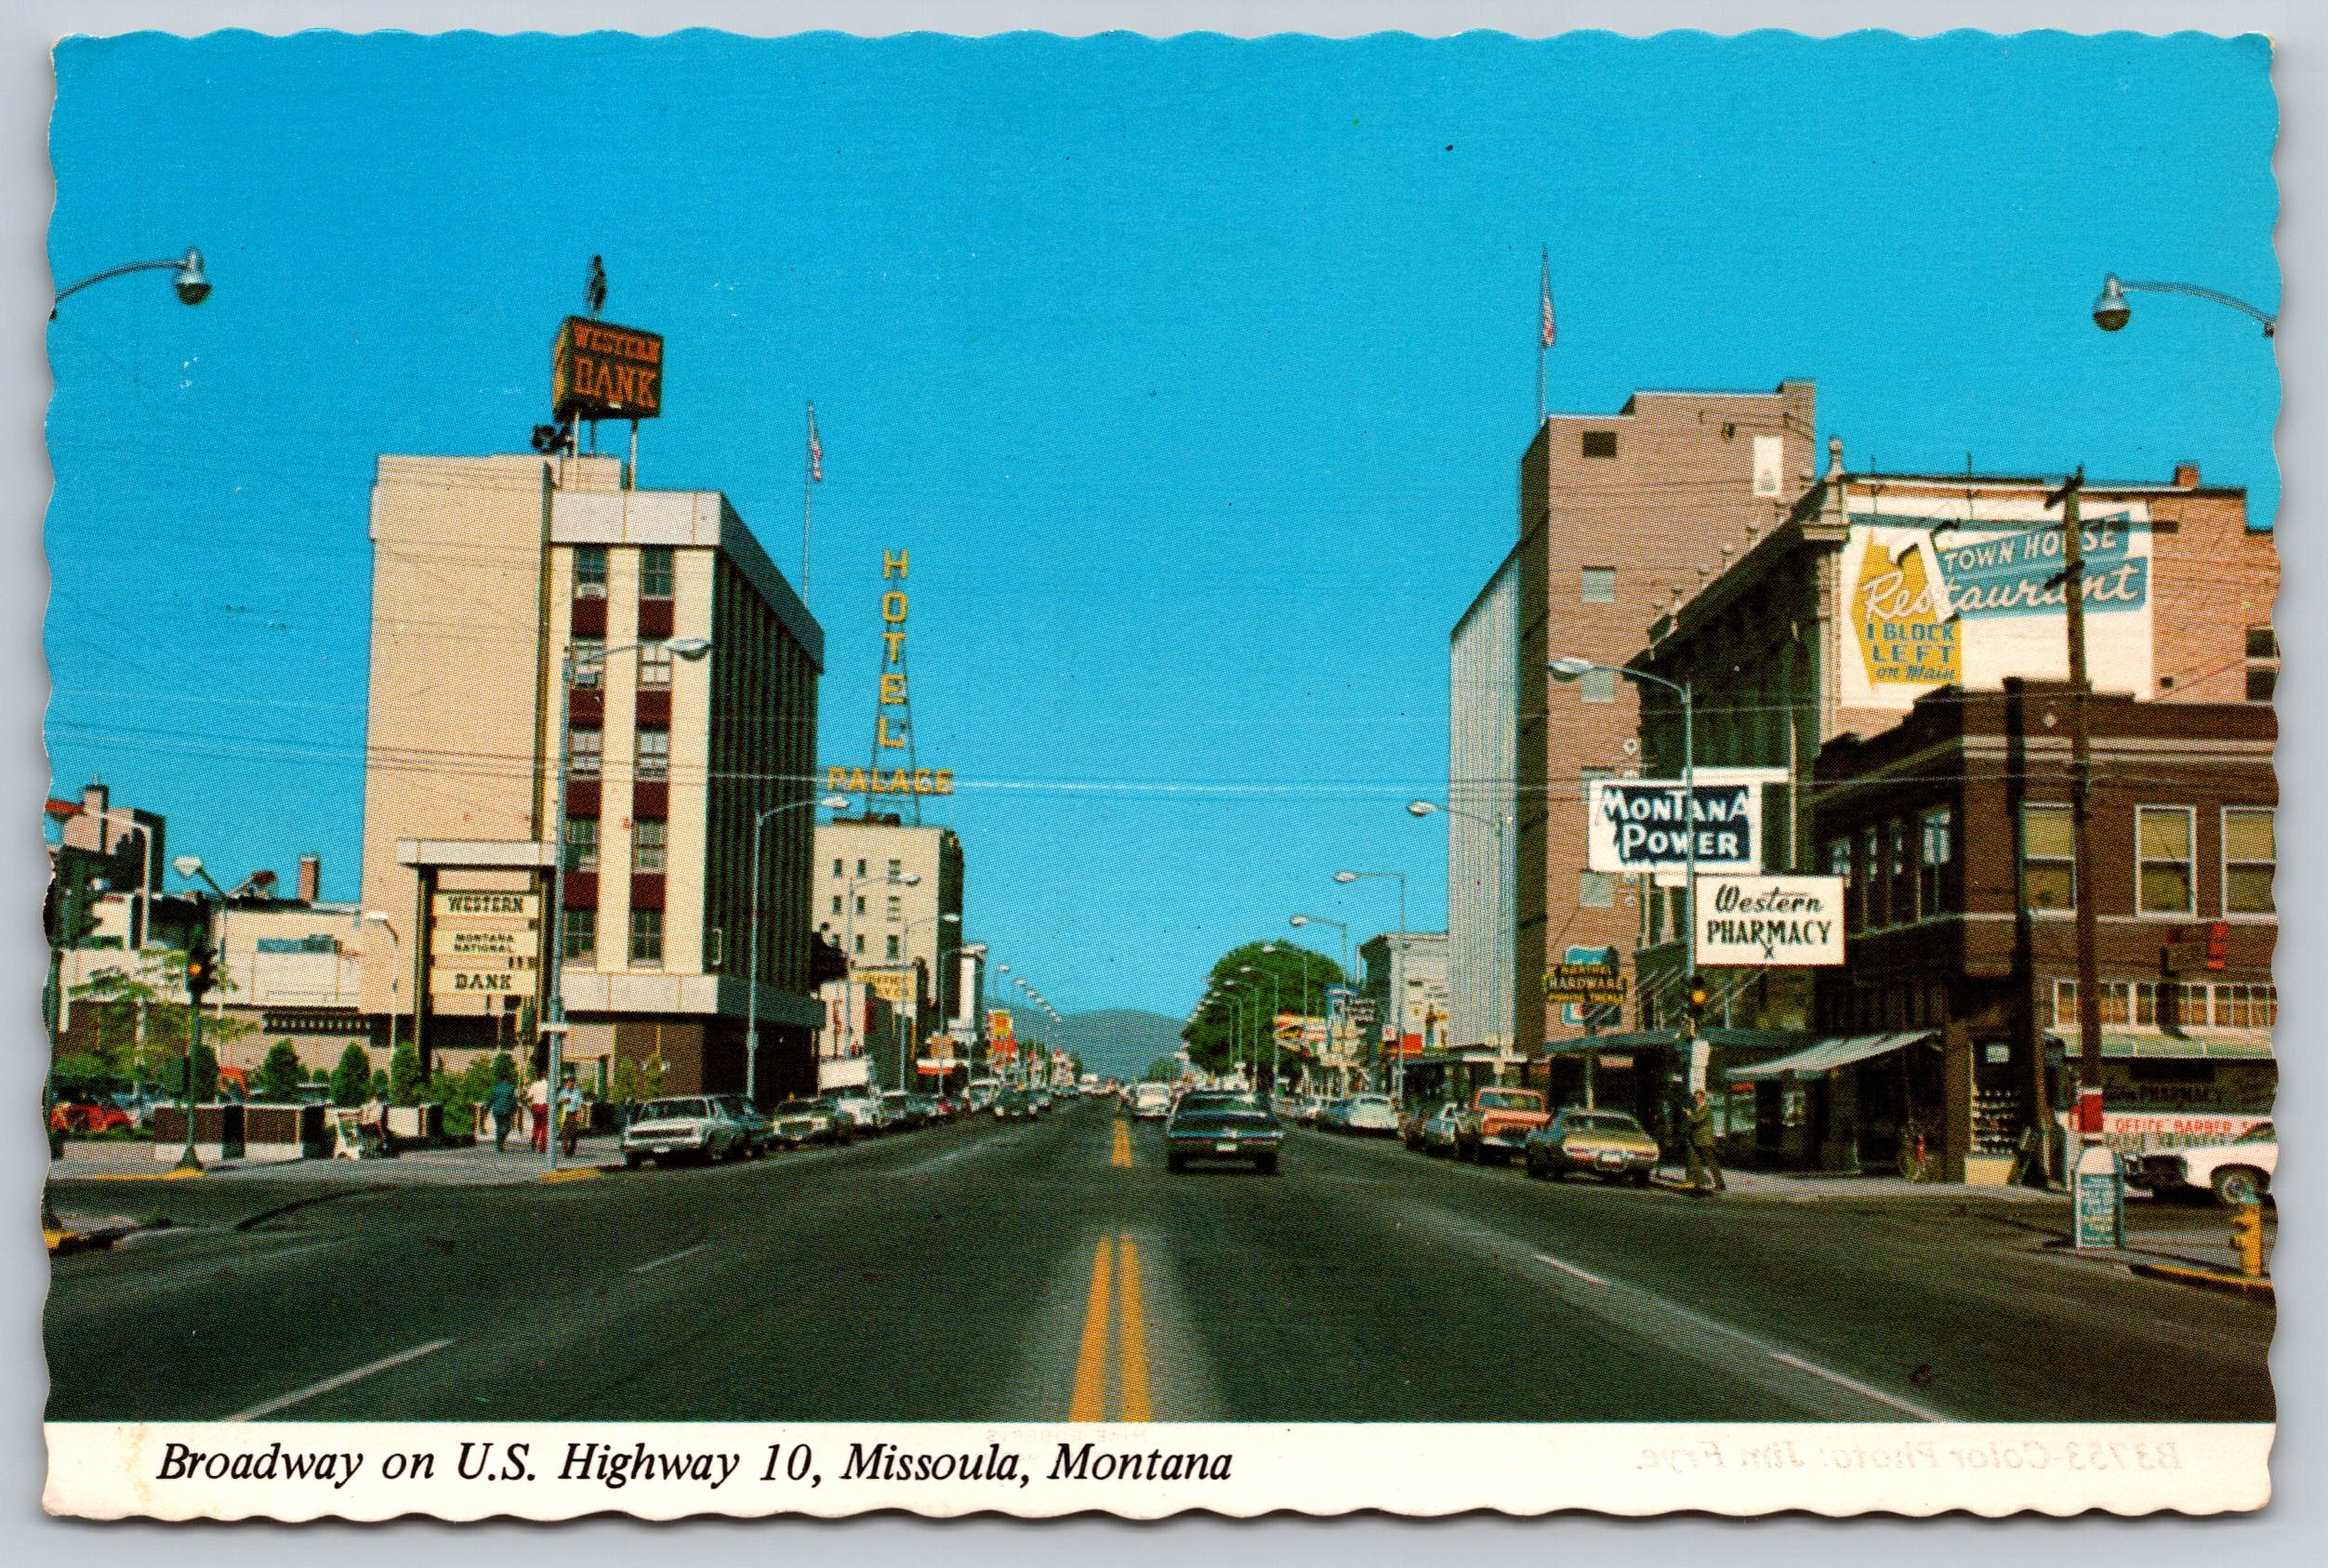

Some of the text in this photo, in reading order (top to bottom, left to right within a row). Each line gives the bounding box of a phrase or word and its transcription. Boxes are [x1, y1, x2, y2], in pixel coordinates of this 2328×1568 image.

[573, 323, 661, 363] WESTERN
[573, 355, 658, 408] BANK
[1944, 528, 2117, 573] TOWN HOSE
[1883, 622, 1955, 641] BLOCK
[880, 548, 909, 748] HOTEL
[1872, 644, 1956, 665] LEFT
[827, 766, 953, 795] PALACE
[1603, 788, 1752, 822] MONTANA
[1623, 823, 1740, 859] POWER
[447, 895, 523, 913] WESTERN
[1715, 883, 1825, 914] Western
[456, 933, 513, 943] MONTANA
[1707, 918, 1832, 945] PHARMACY
[454, 943, 513, 954] NATIONAL
[455, 972, 511, 990] BANK
[1549, 977, 1622, 990] HARDWARE
[2115, 1118, 2163, 1133] OFFICE
[2174, 1118, 2231, 1133] BARBER
